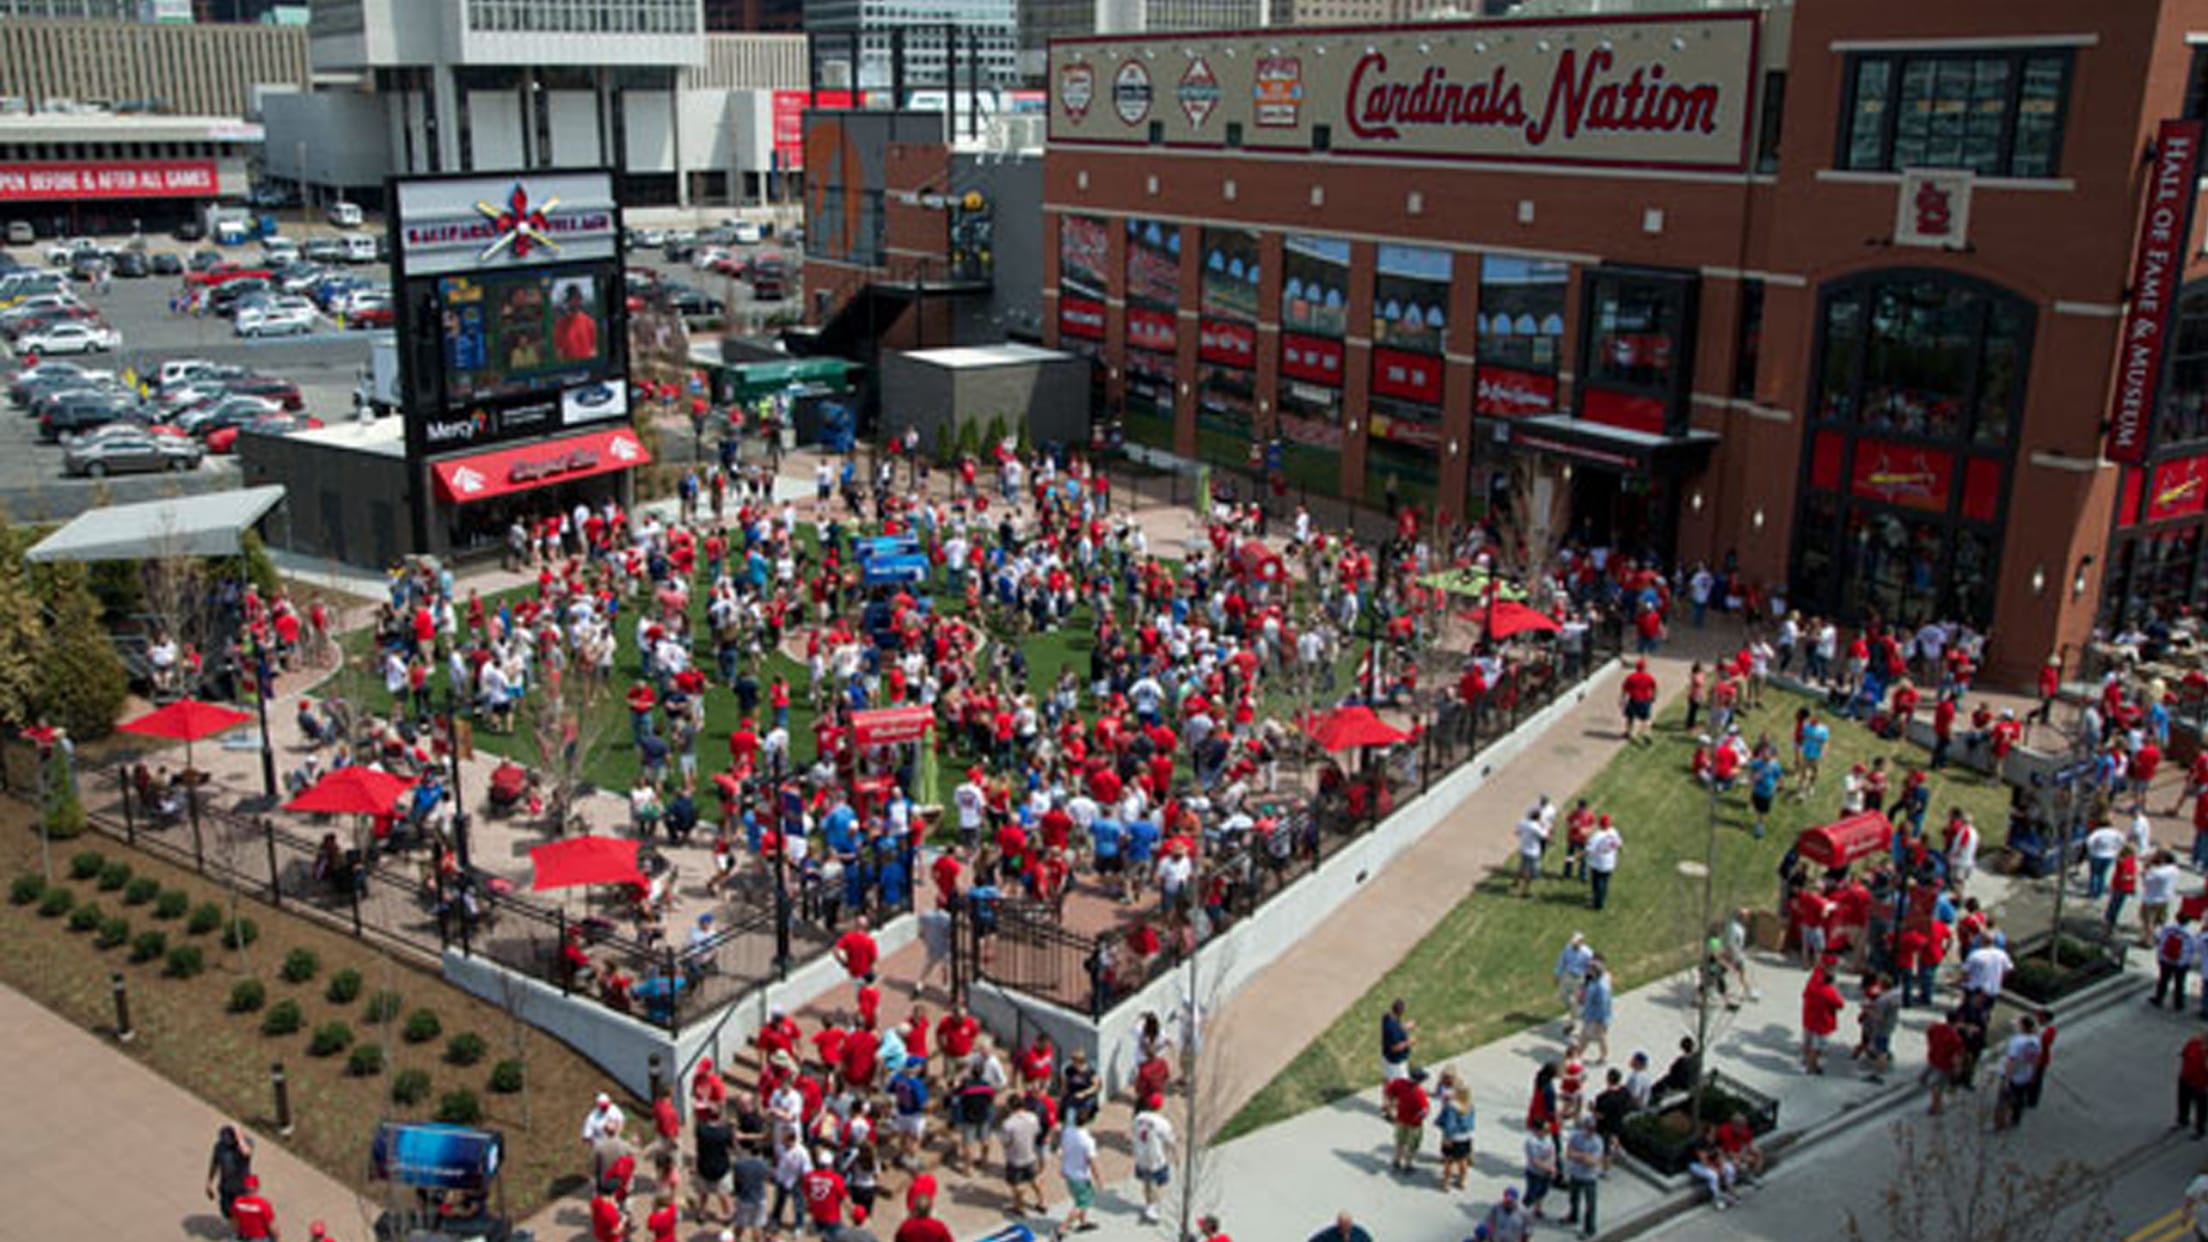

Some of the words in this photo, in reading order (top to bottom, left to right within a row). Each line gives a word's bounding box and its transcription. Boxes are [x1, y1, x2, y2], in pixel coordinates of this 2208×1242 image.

[1345, 52, 1528, 140] Cardinals
[1525, 48, 1719, 146] Nation
[29, 171, 78, 191] BEFORE
[83, 171, 96, 190] &
[98, 170, 137, 190] AFTER
[141, 170, 163, 189] ALL
[165, 169, 211, 188] GAMES
[2157, 137, 2190, 201] HALL
[2151, 207, 2176, 242] OF
[2138, 250, 2170, 313] FAME
[2132, 318, 2157, 340] &
[2116, 344, 2152, 447] MUSEUM
